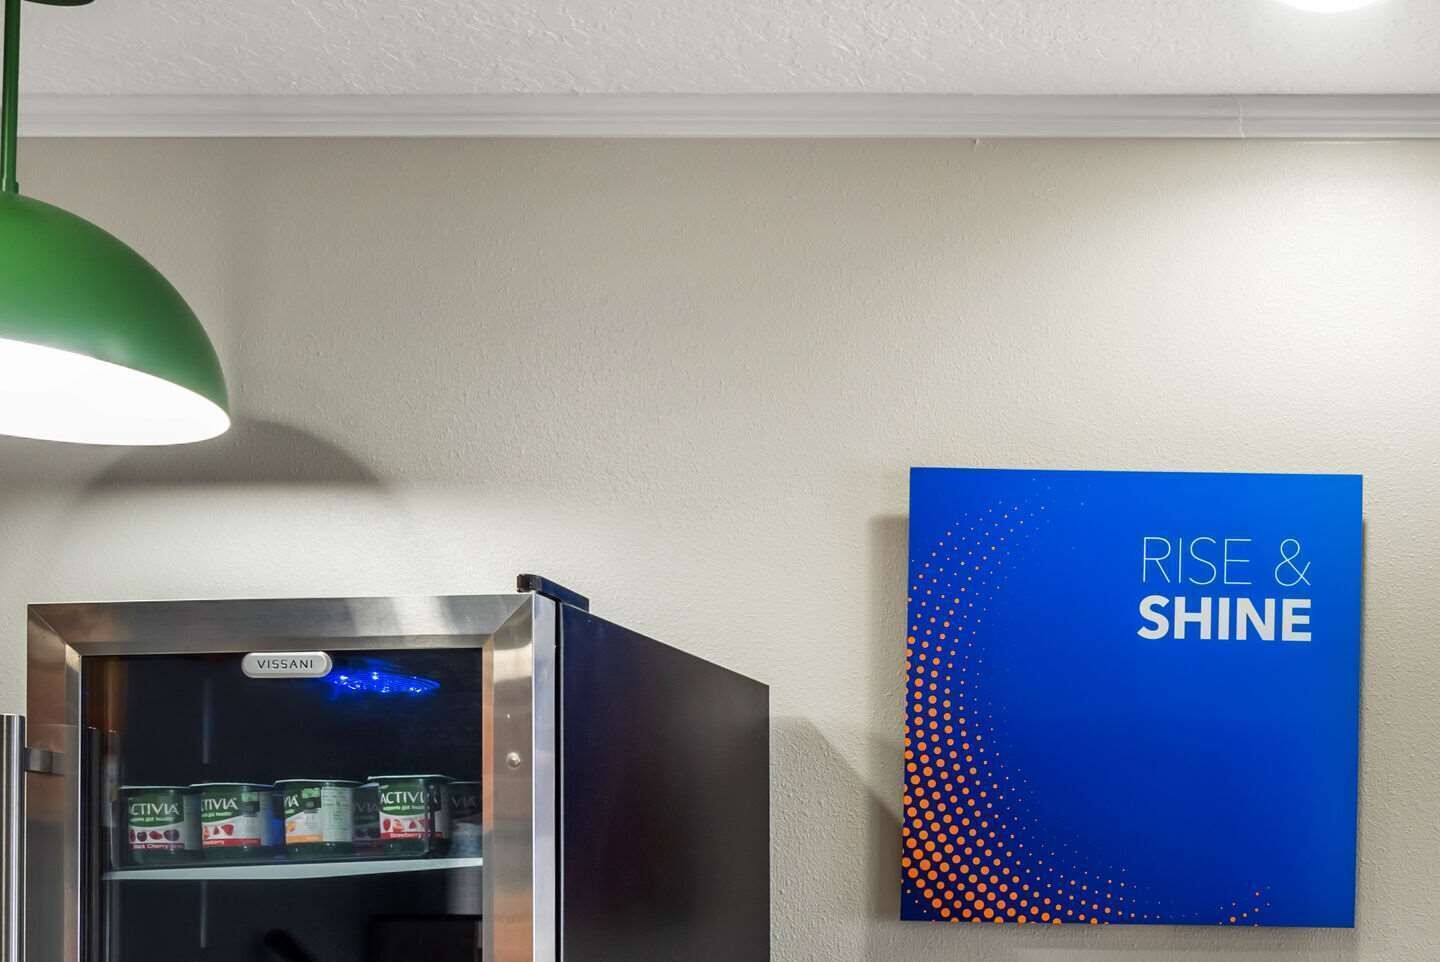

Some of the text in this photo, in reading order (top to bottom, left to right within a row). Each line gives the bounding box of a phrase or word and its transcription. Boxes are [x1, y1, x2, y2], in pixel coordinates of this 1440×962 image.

[1142, 536, 1311, 587] RISE &
[1137, 595, 1312, 642] SHINE
[257, 659, 313, 669] VISSANI
[128, 803, 180, 816] CTIVIA
